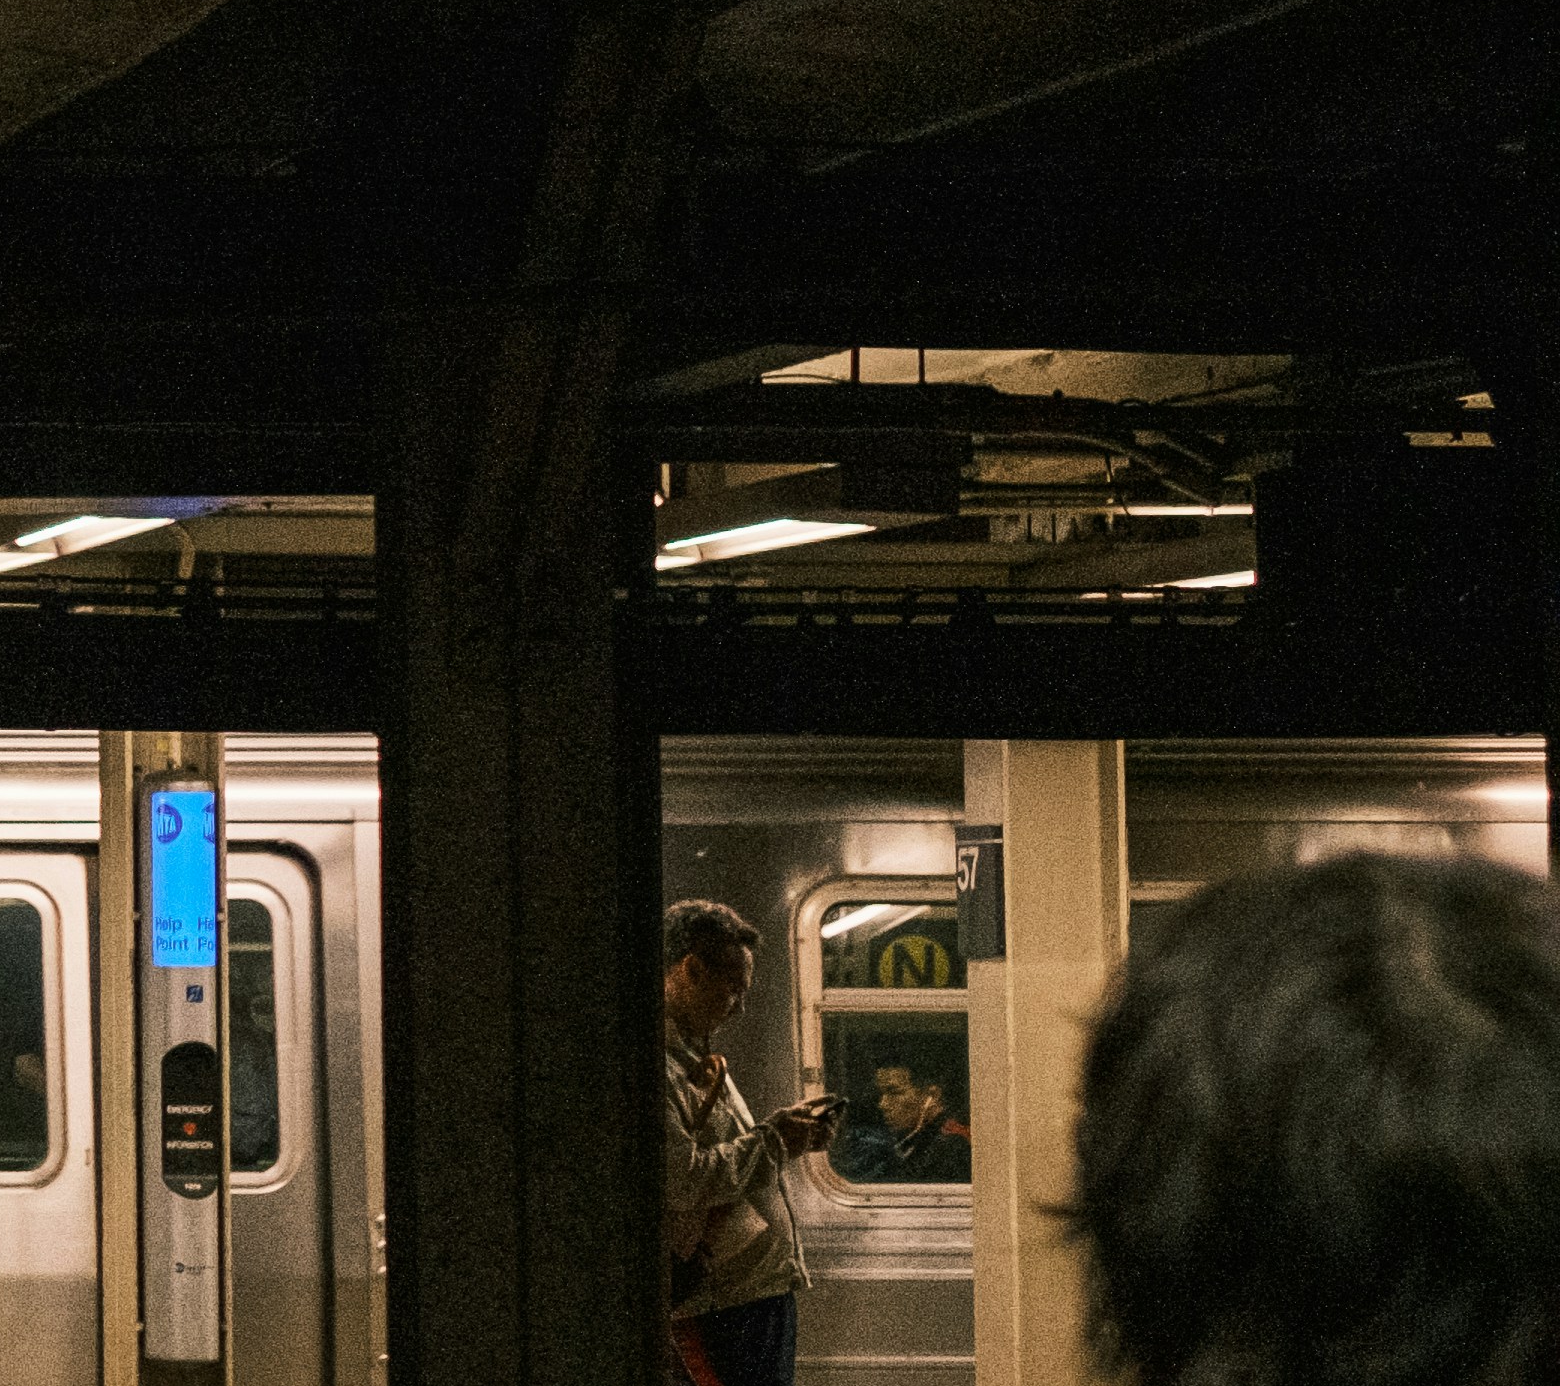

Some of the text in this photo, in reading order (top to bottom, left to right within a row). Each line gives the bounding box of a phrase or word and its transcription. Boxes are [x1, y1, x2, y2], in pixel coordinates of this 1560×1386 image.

[957, 846, 979, 892] 57
[155, 916, 182, 933] Help
[156, 936, 189, 951] Point
[892, 943, 935, 988] N
